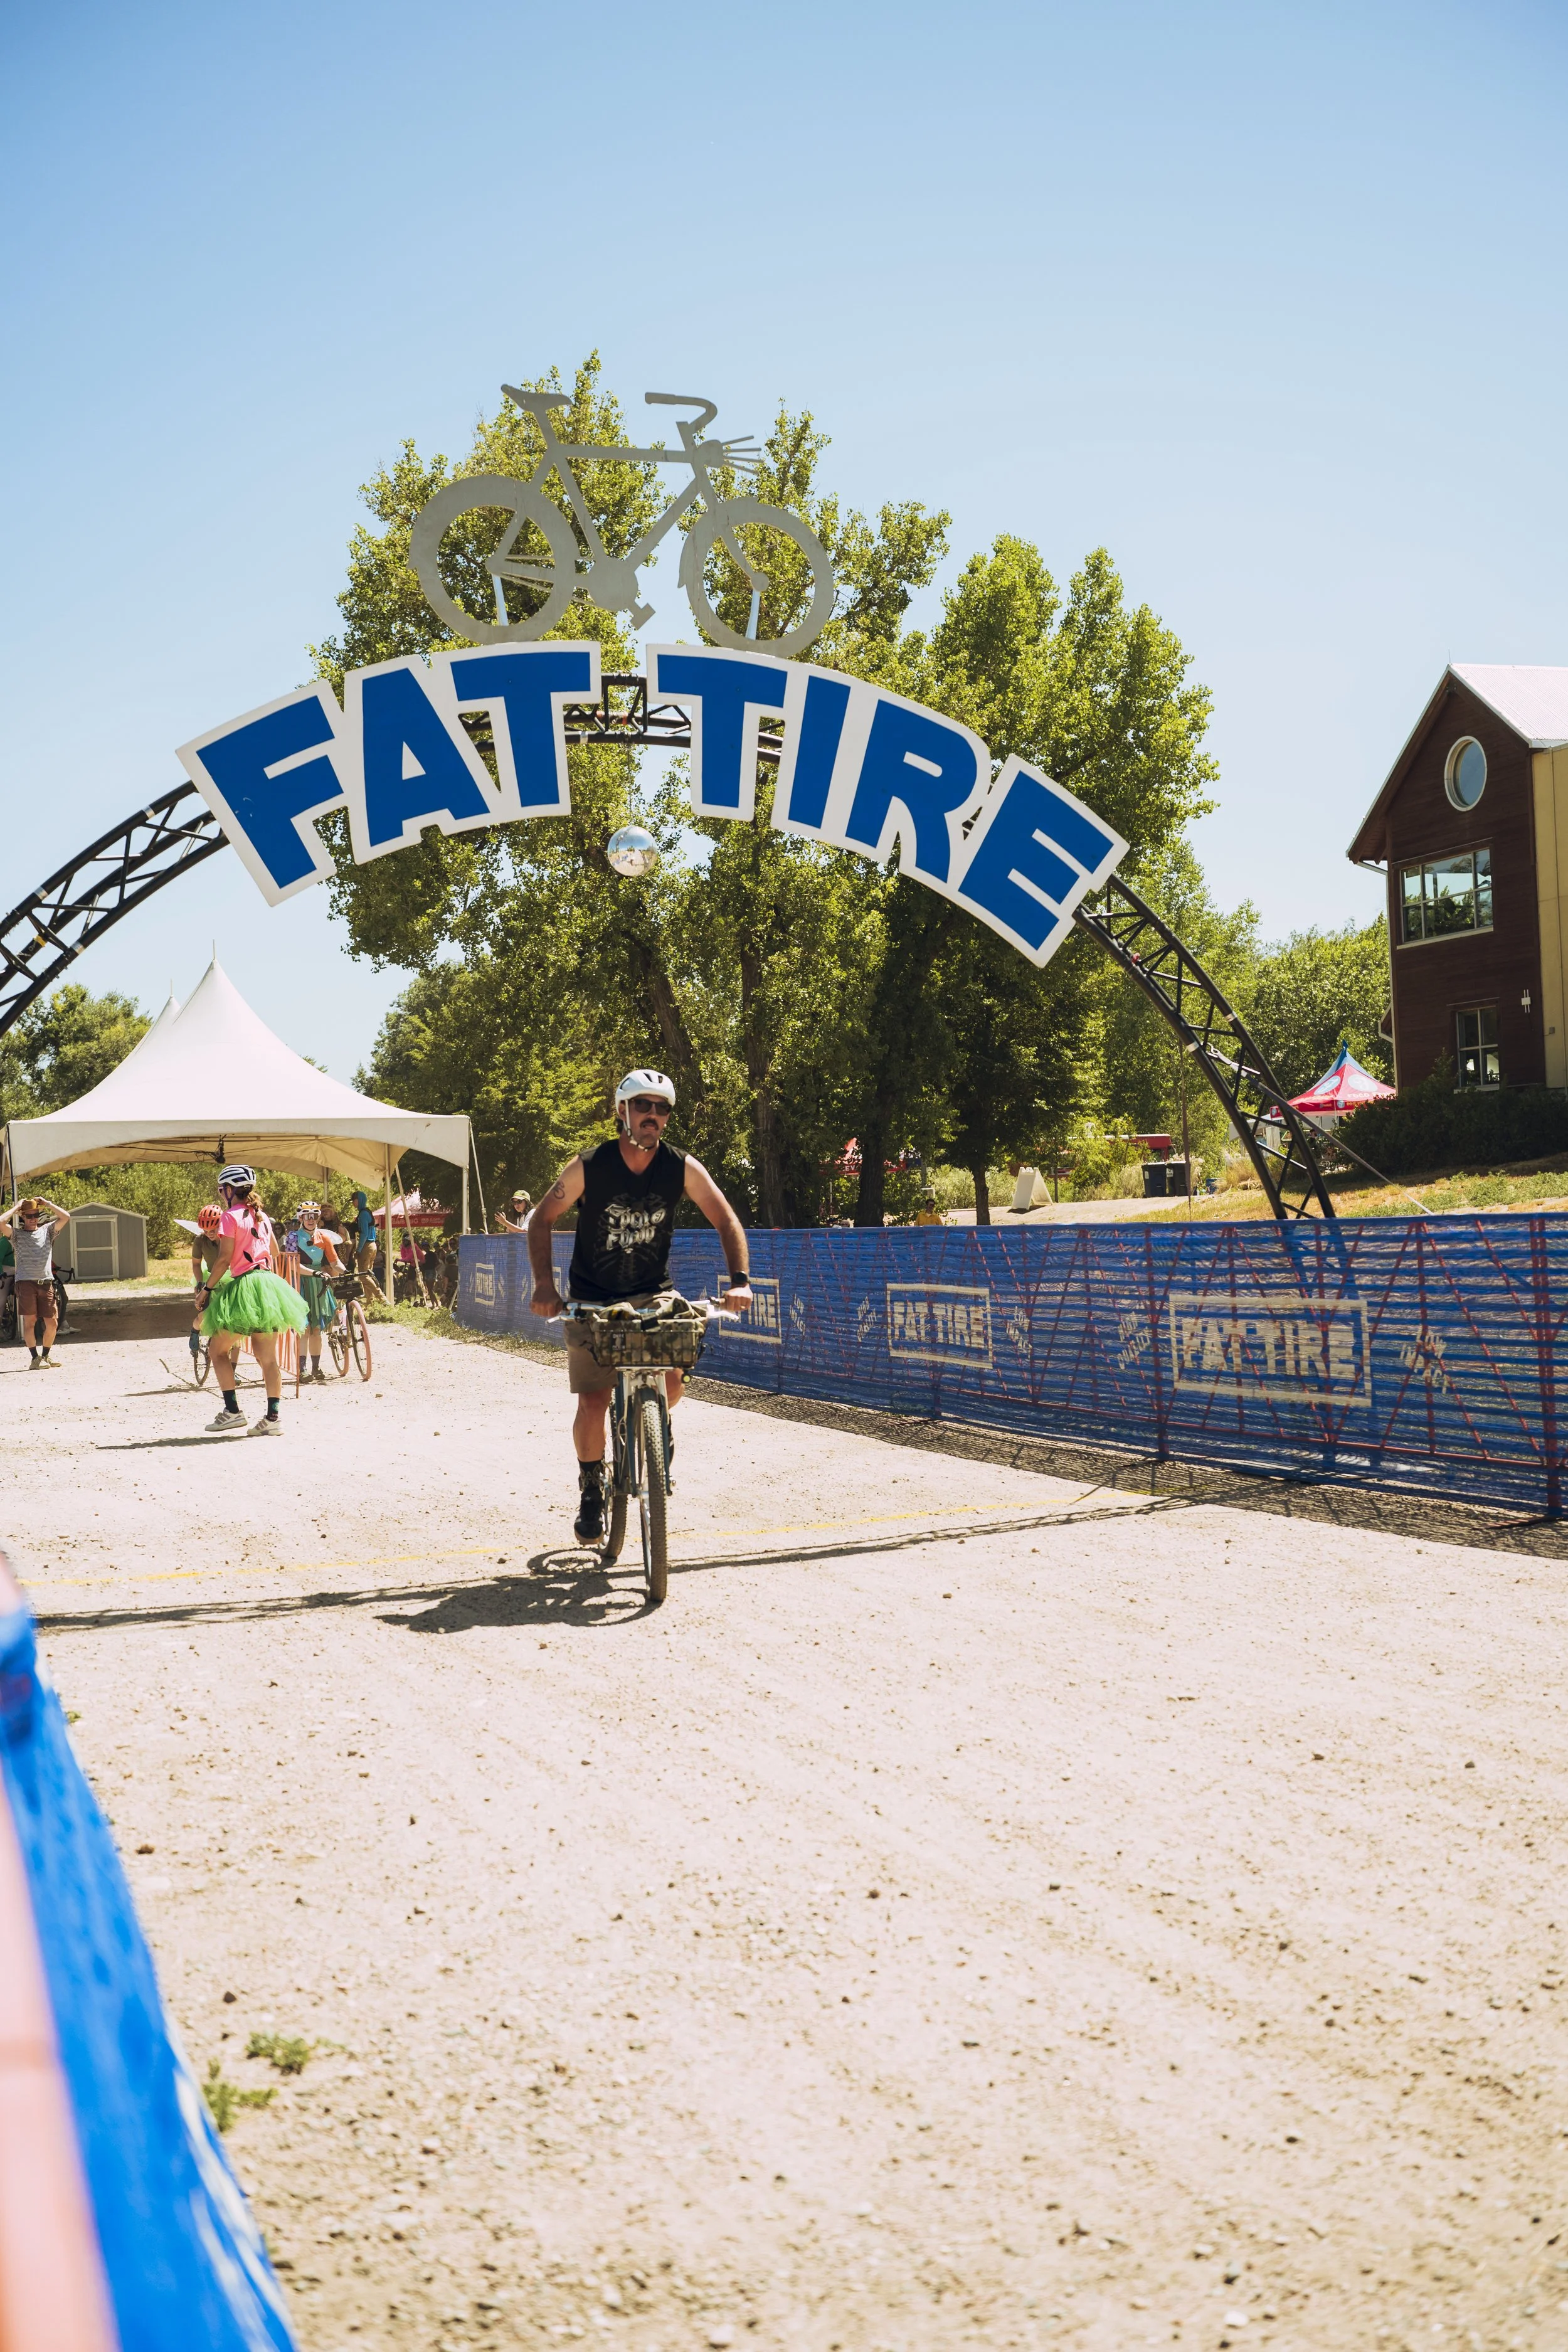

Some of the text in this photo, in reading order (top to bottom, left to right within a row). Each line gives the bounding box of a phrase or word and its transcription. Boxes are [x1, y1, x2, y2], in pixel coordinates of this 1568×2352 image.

[196, 651, 1114, 950] FAT TIRE
[893, 1301, 985, 1348] FAT TIRE
[1182, 1318, 1356, 1378] FAT TIRE
